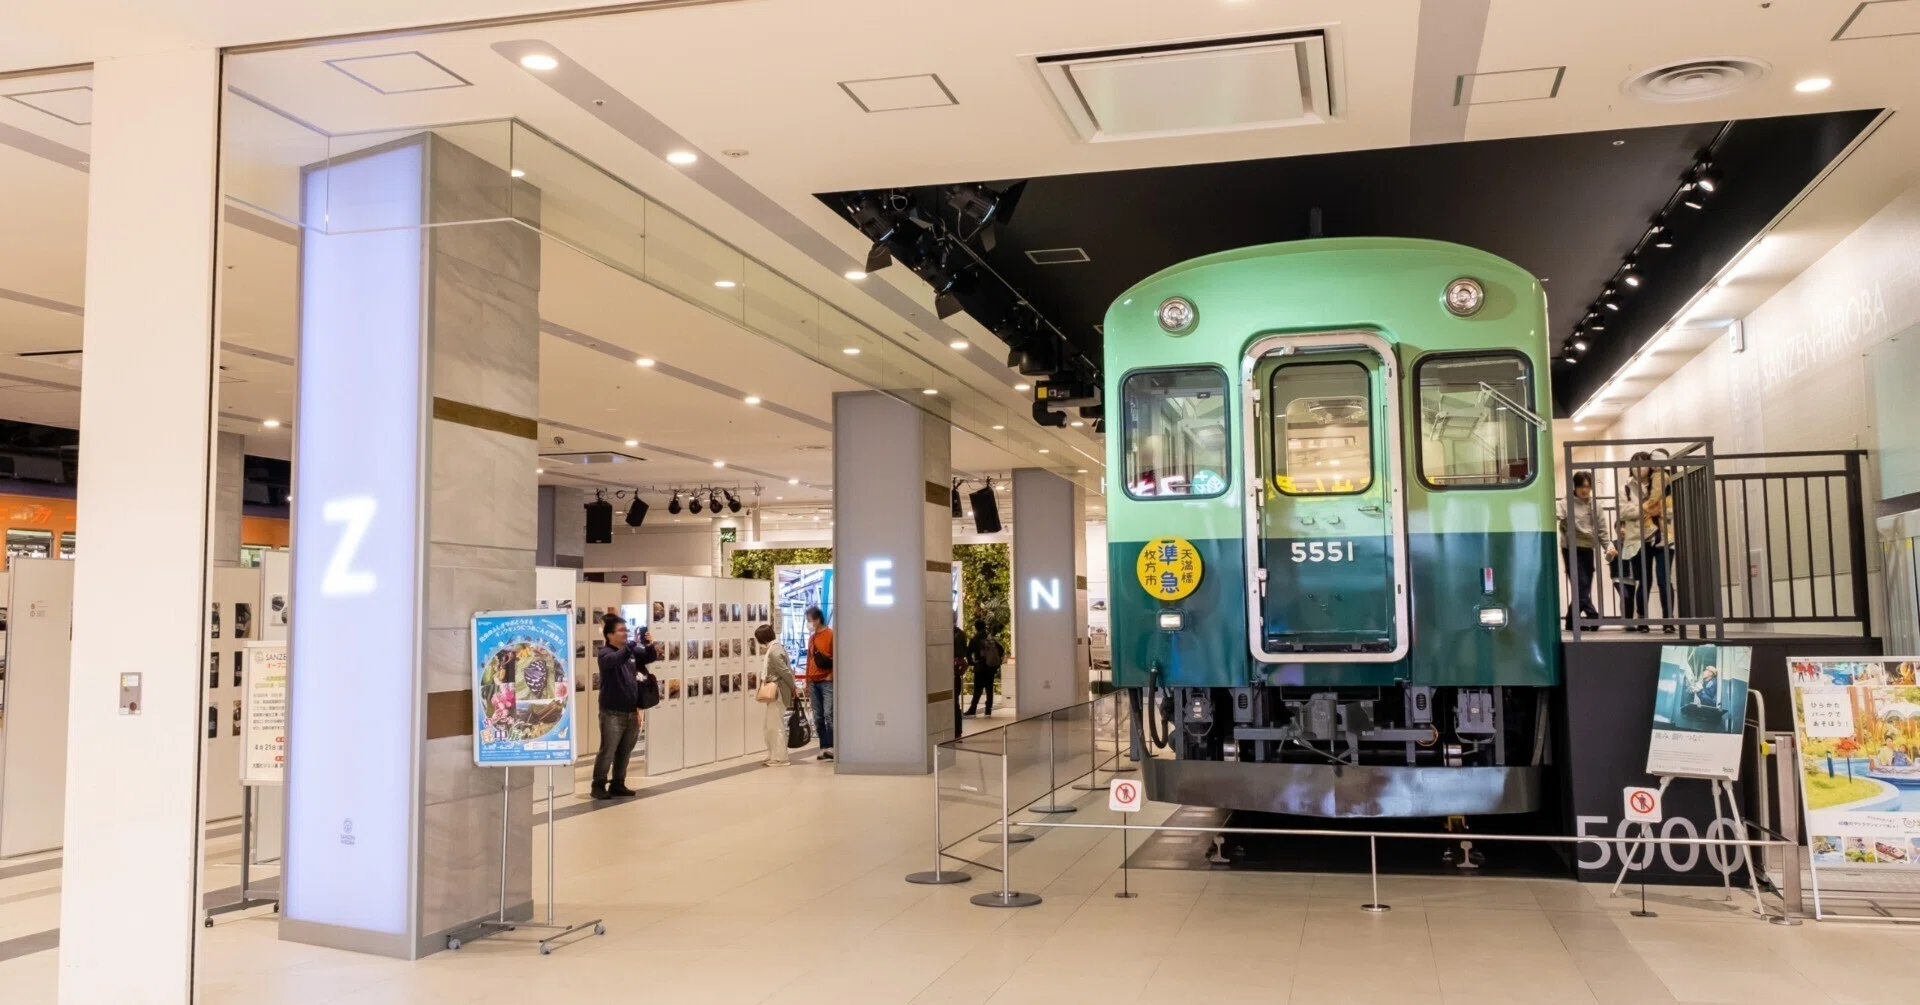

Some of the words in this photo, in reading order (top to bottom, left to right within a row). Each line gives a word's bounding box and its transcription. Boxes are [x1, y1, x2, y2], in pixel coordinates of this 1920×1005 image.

[322, 496, 377, 595] Z
[1181, 548, 1194, 584] 天満橋
[1291, 541, 1354, 562] 5551
[865, 559, 894, 606] E
[1144, 549, 1157, 586] 枚方市
[1158, 544, 1180, 594] 準急
[1030, 578, 1060, 610] N
[1577, 815, 1745, 874] 5000
